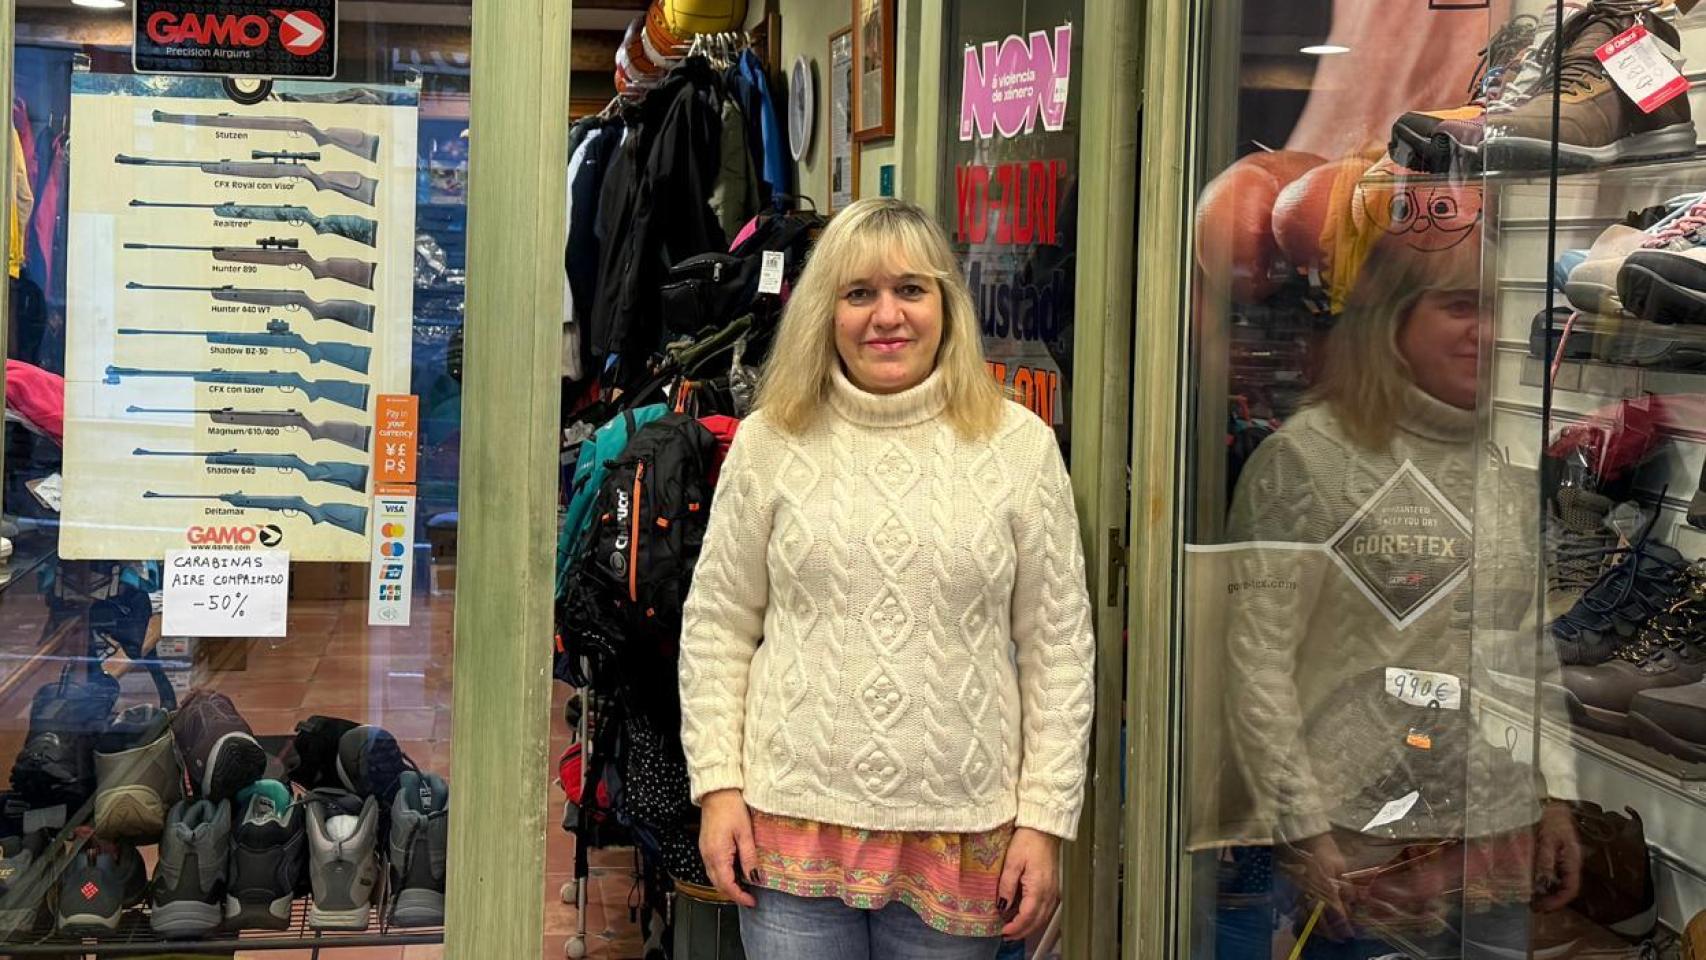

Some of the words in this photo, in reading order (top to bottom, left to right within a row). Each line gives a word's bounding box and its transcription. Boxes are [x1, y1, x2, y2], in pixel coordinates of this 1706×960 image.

[147, 11, 270, 47] GAMO
[166, 47, 211, 57] Precision
[213, 48, 250, 59] Airguns
[960, 26, 1071, 141] NON
[998, 69, 1036, 88] violencia
[991, 90, 1003, 103] de
[215, 131, 249, 139] Stutzen
[232, 181, 255, 190] Royal
[274, 182, 295, 190] Visor
[956, 160, 1057, 245] YO-ZURI
[210, 346, 243, 354] Shadow
[208, 385, 224, 393] CFX
[244, 386, 265, 394] laser
[386, 409, 400, 419] Pay
[401, 409, 409, 417] in
[387, 421, 406, 430] your
[378, 429, 414, 439] currency
[206, 466, 240, 474] Shadow
[385, 505, 405, 513] VISA
[187, 526, 257, 544] GAMO
[1352, 534, 1457, 557] GORE-TEX
[173, 556, 264, 568] CARABINAS
[172, 574, 205, 588] AIRE
[213, 573, 284, 586] COMPRIMIDO
[193, 592, 249, 618] -50%
